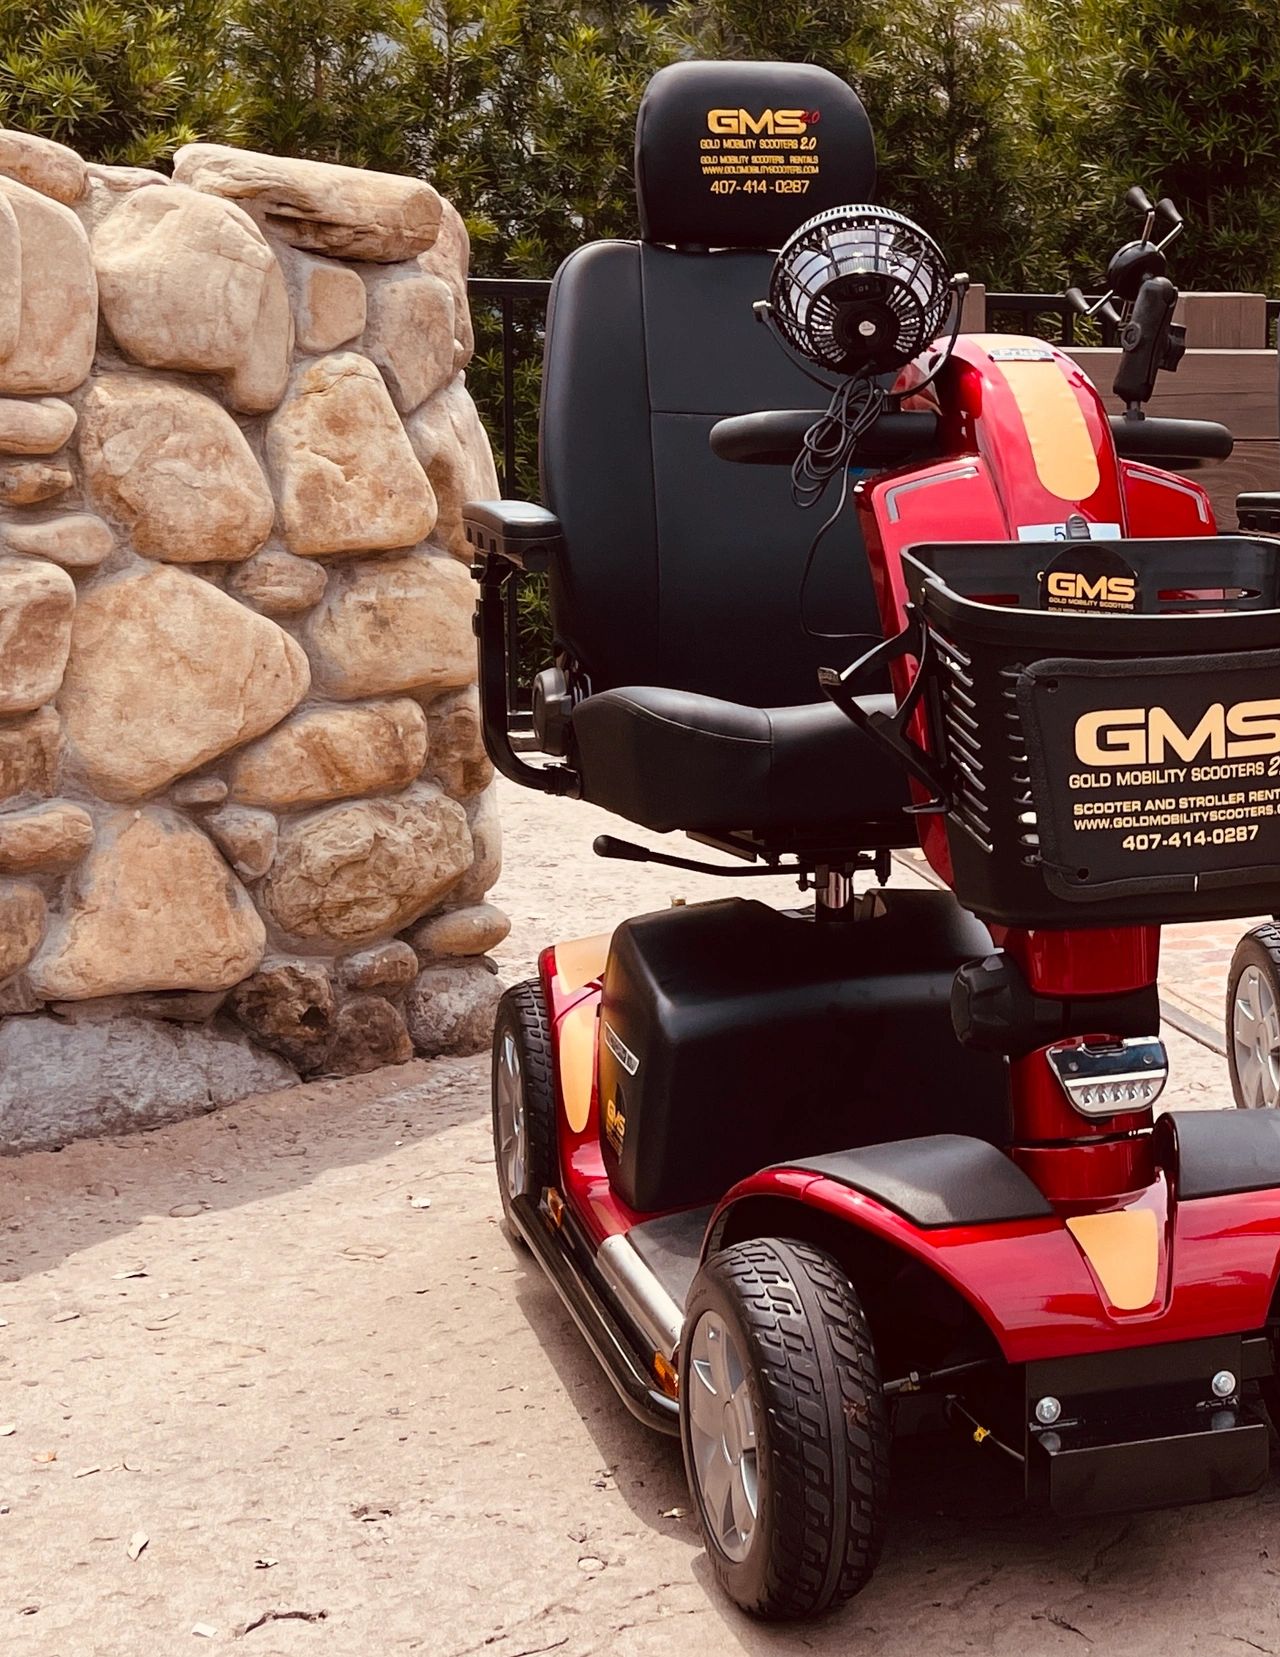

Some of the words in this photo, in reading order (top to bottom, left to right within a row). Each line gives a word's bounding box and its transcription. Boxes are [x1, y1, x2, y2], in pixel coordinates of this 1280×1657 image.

[707, 108, 807, 135] GMS
[700, 138, 721, 149] GOLD
[722, 138, 756, 149] MOBILITY
[759, 138, 798, 149] SCOOTERS
[799, 136, 817, 150] 2.0
[710, 180, 810, 194] 407-414-0287
[1048, 572, 1136, 602] GMS
[1069, 772, 1111, 789] GOLD
[1116, 768, 1188, 787] MOBILITY
[1191, 762, 1264, 781] SCOOTERS
[1073, 801, 1141, 816] SCOOTER
[1144, 798, 1176, 812] AND
[1179, 792, 1245, 810] STROLLER
[1122, 824, 1259, 851] 407-414-0287
